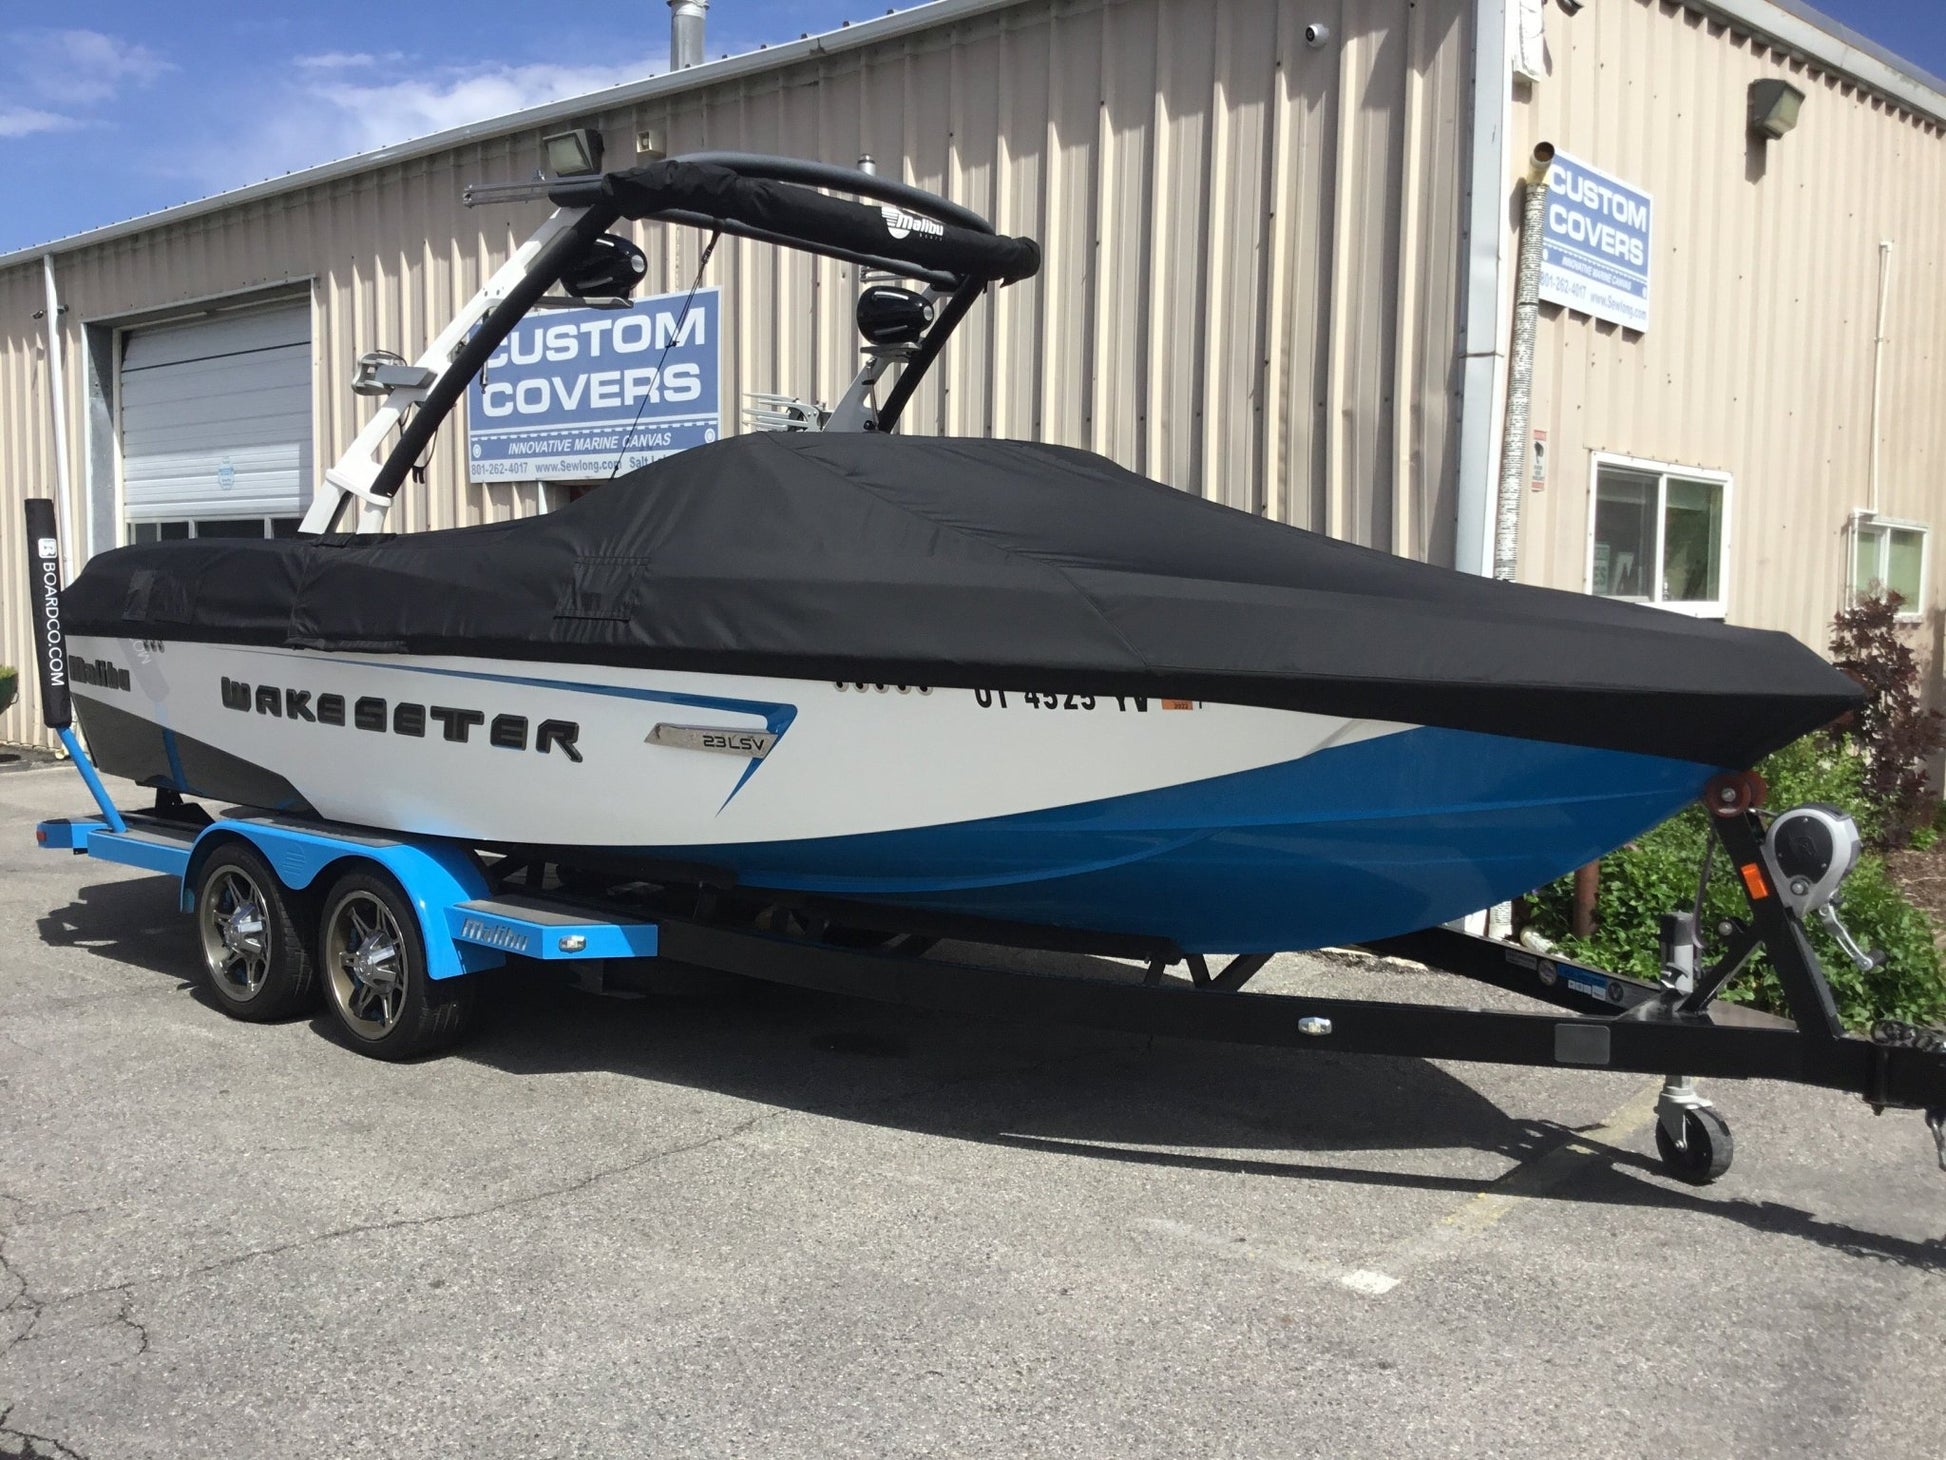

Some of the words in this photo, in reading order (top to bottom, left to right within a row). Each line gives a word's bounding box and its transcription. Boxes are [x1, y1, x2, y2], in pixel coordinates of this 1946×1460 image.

[1549, 163, 1647, 232] CUSTOM
[1550, 204, 1643, 266] COVERS
[482, 363, 702, 417] COVERS
[471, 462, 528, 475] 801-262-4017
[535, 459, 622, 474] www.Sewlong.com
[508, 439, 572, 455] INNOVATIVE
[574, 435, 619, 451] MARINE
[622, 432, 672, 448] CANVAS
[42, 562, 65, 686] BOARDCO.COM
[220, 675, 583, 763] WAKESETTER
[703, 735, 765, 751] 23LSV
